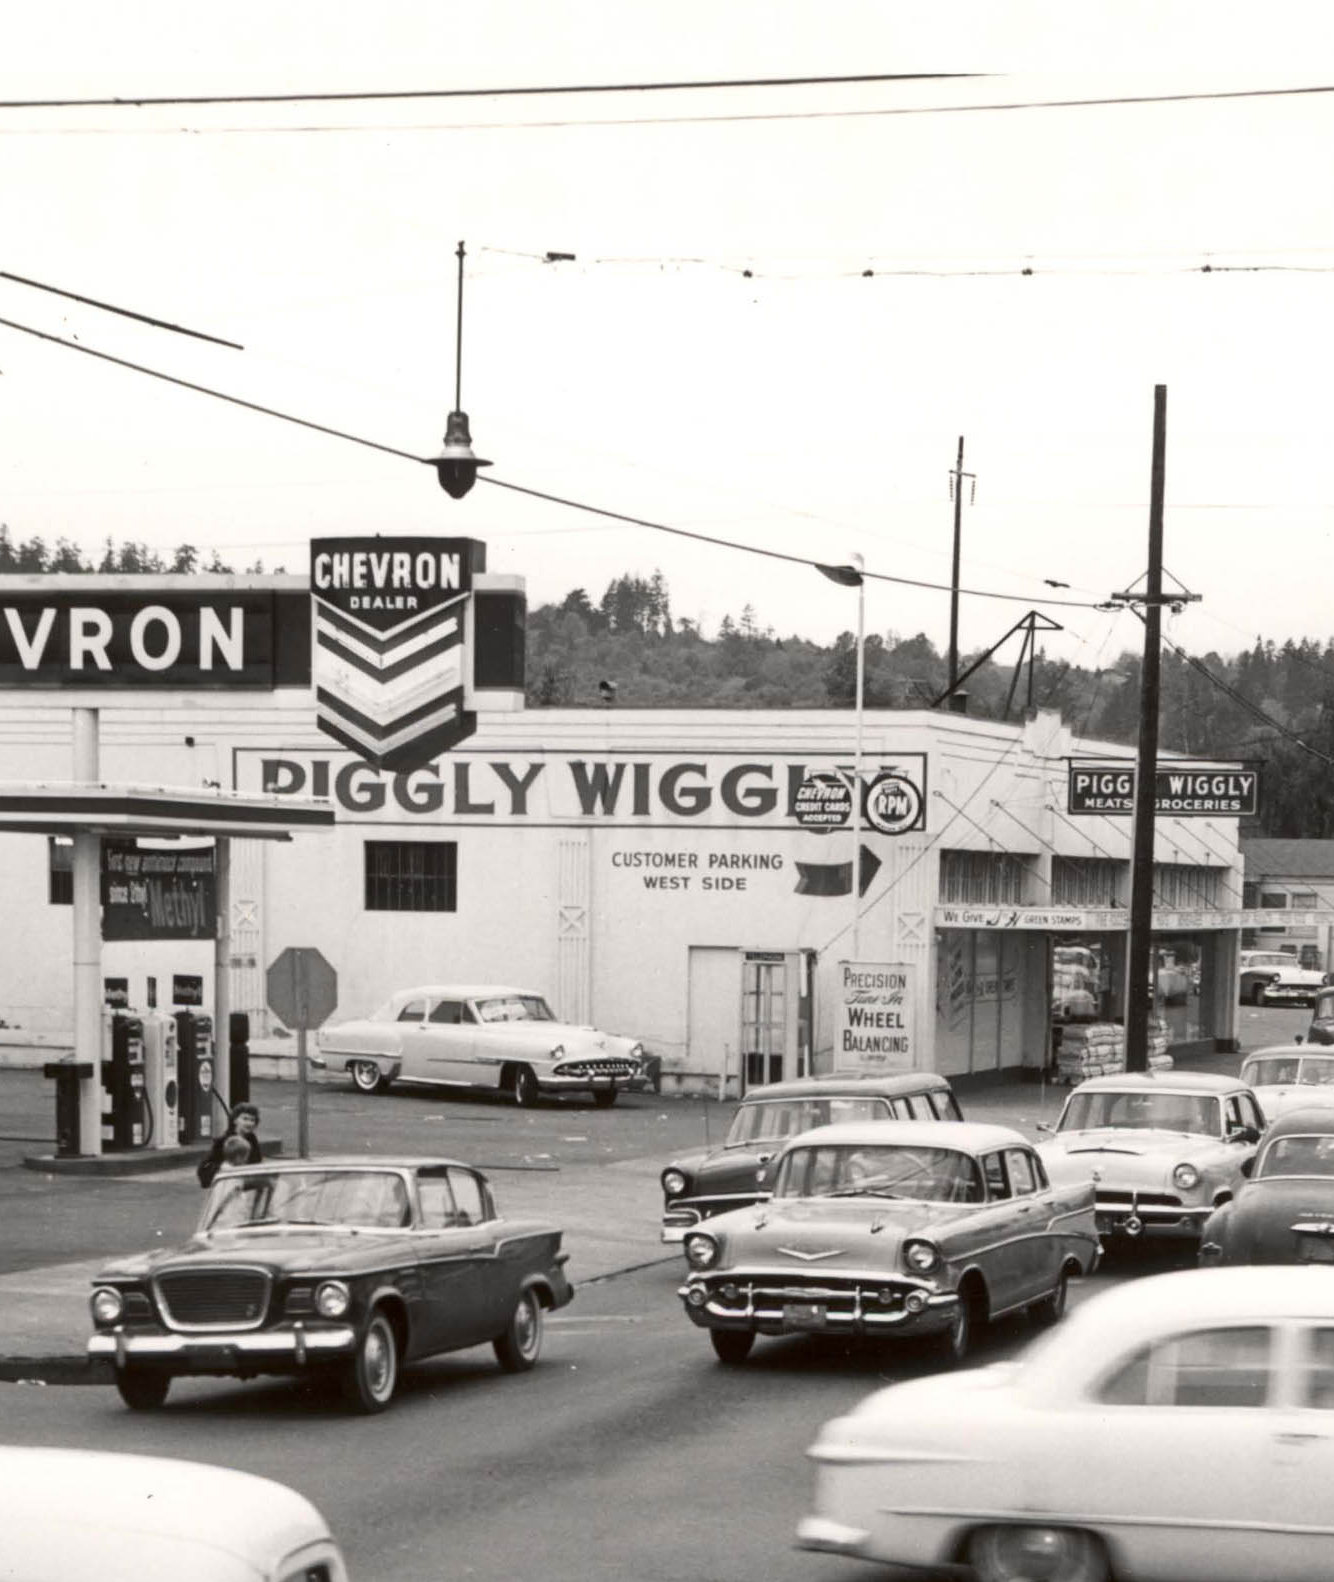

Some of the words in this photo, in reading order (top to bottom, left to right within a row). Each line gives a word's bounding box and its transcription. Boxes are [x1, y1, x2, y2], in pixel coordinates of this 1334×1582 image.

[315, 552, 461, 590] CHEVRON
[350, 596, 419, 609] DEALER
[797, 787, 847, 800] CHEVRON
[1169, 776, 1253, 796] WIGGLY
[795, 802, 823, 812] CREDIT
[878, 794, 908, 815] RPM
[1084, 798, 1134, 809] MEATS
[612, 852, 698, 868] CUSTOMER
[709, 853, 783, 870] PARKING
[643, 876, 691, 890] WEST
[702, 877, 747, 890] SIDE
[1024, 913, 1049, 925] GREEN
[1052, 914, 1083, 926] STAMPS
[843, 967, 906, 989] PRECISION
[848, 1007, 905, 1029] WHEEL
[843, 1029, 909, 1053] BALANCING
